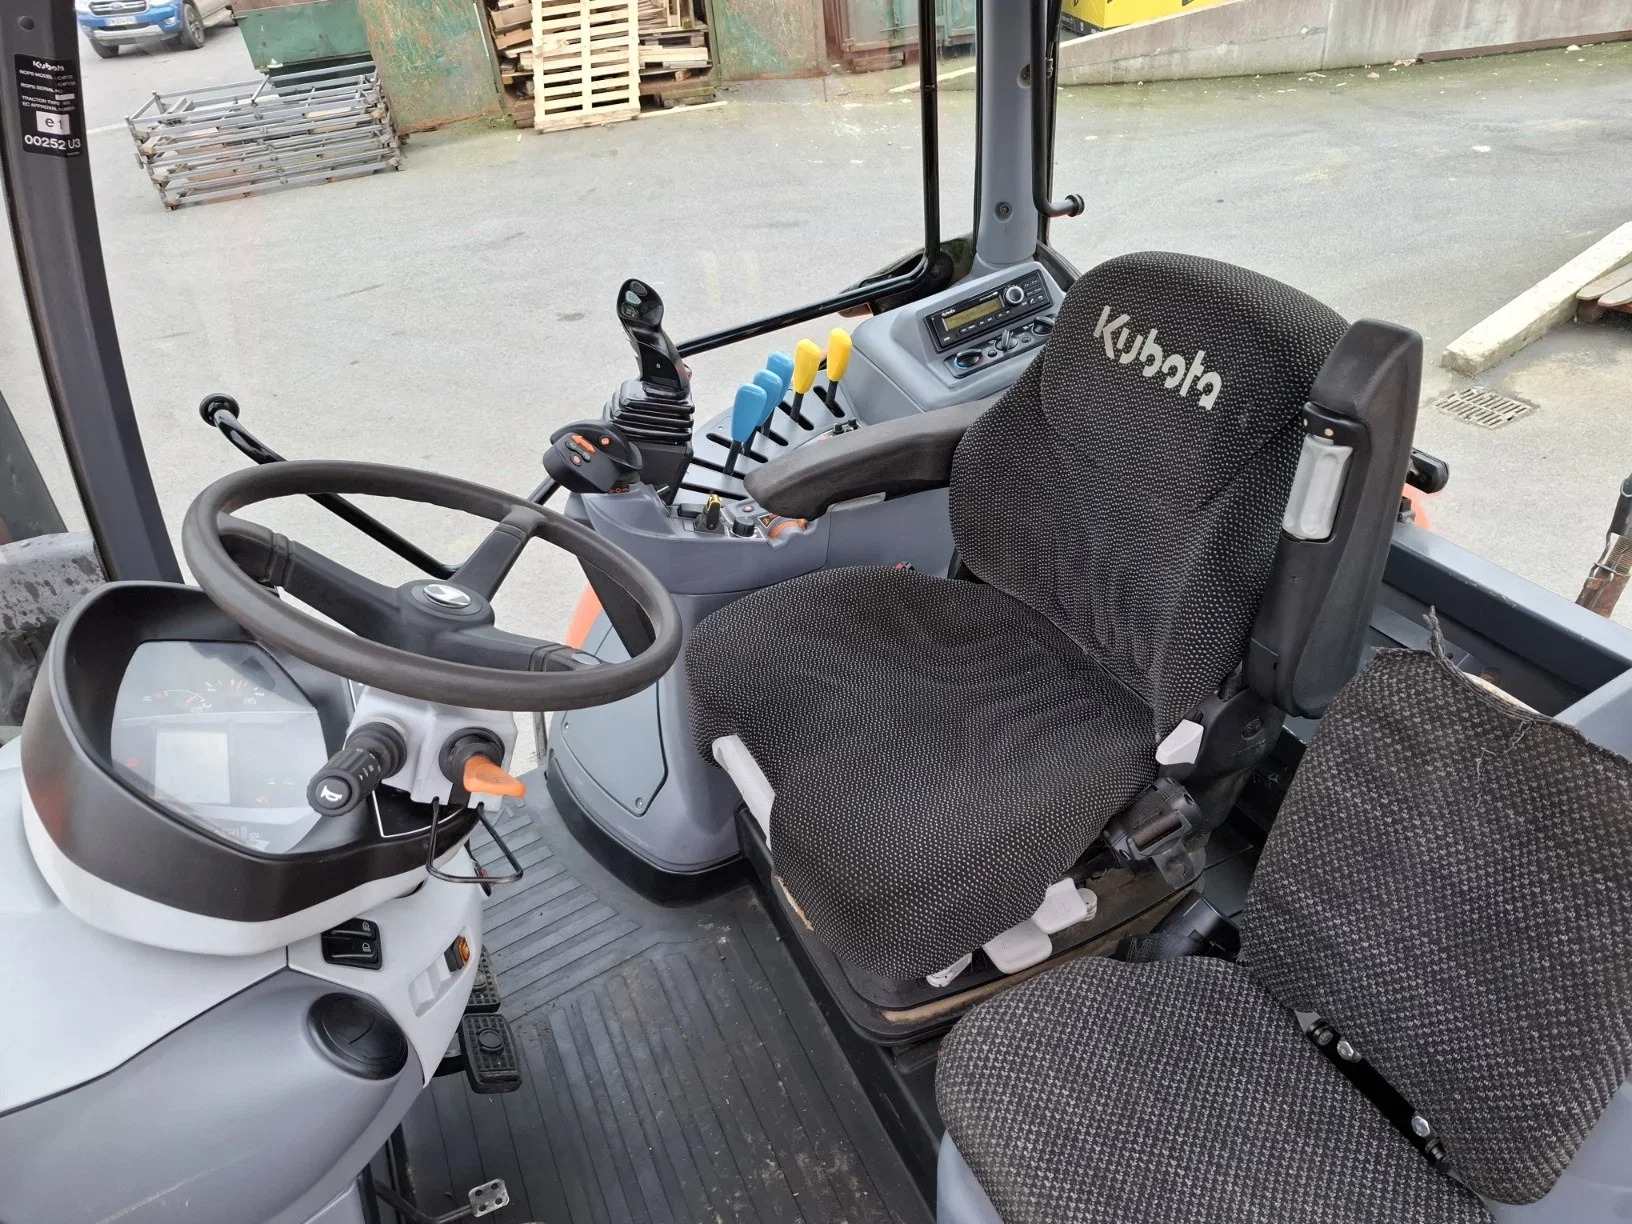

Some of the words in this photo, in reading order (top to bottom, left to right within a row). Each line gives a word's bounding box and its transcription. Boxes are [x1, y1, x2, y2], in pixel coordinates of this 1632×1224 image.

[32, 60, 64, 72] Kubota
[35, 72, 53, 80] MODEL
[21, 95, 47, 104] TRACTOR
[24, 134, 67, 150] 00252
[67, 138, 81, 149] U3
[1092, 305, 1222, 411] Kubota
